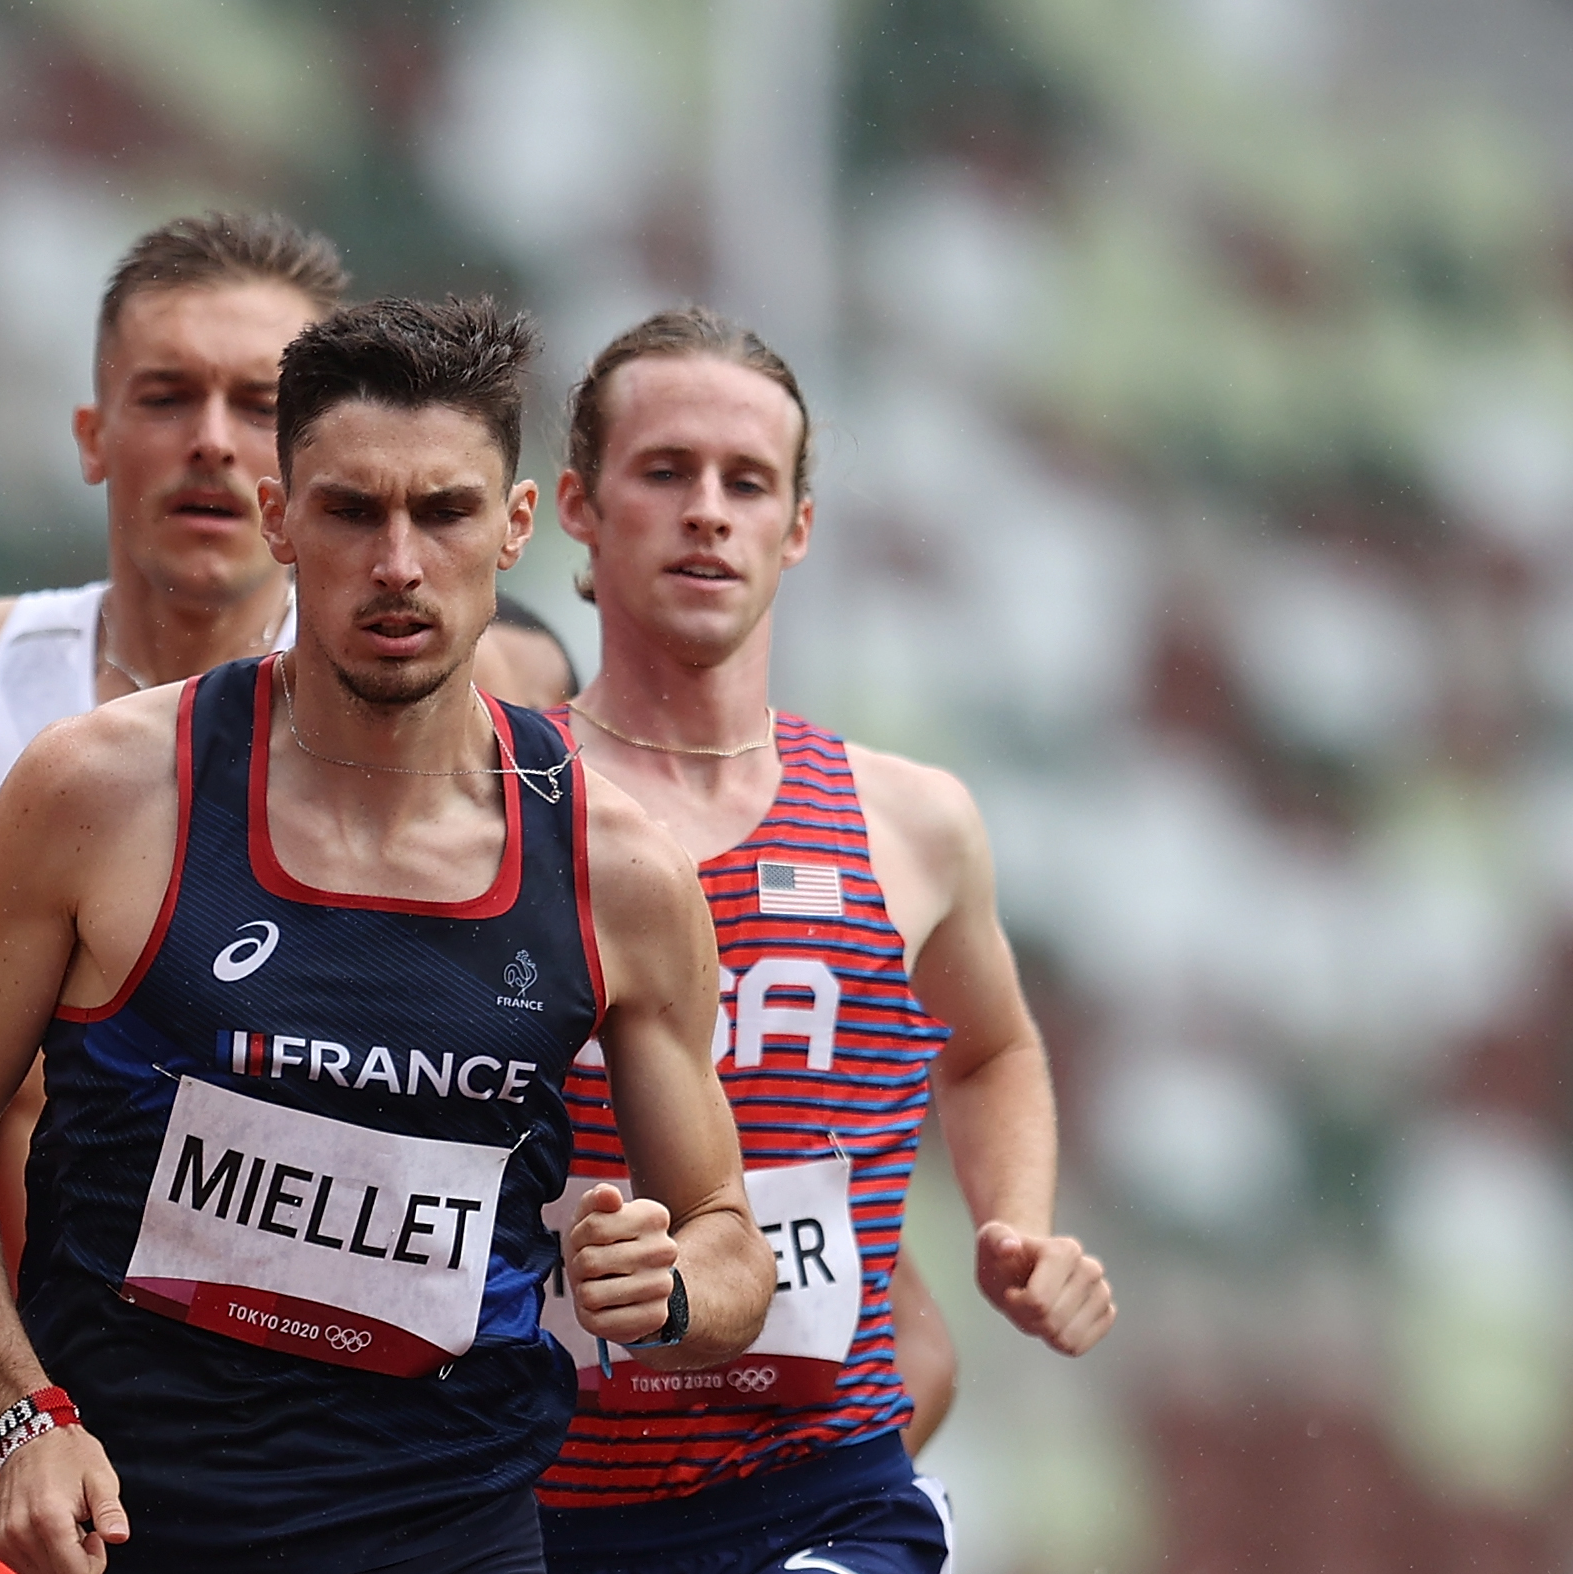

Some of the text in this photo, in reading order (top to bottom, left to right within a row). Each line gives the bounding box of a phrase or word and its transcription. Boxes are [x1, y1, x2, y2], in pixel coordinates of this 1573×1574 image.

[496, 996, 544, 1011] FRANCE
[270, 1034, 538, 1104] FRANCE
[168, 1134, 482, 1271] MIELLET
[228, 1302, 320, 1340] TOKYO 2020
[631, 1375, 722, 1393] TOKYO 2020
